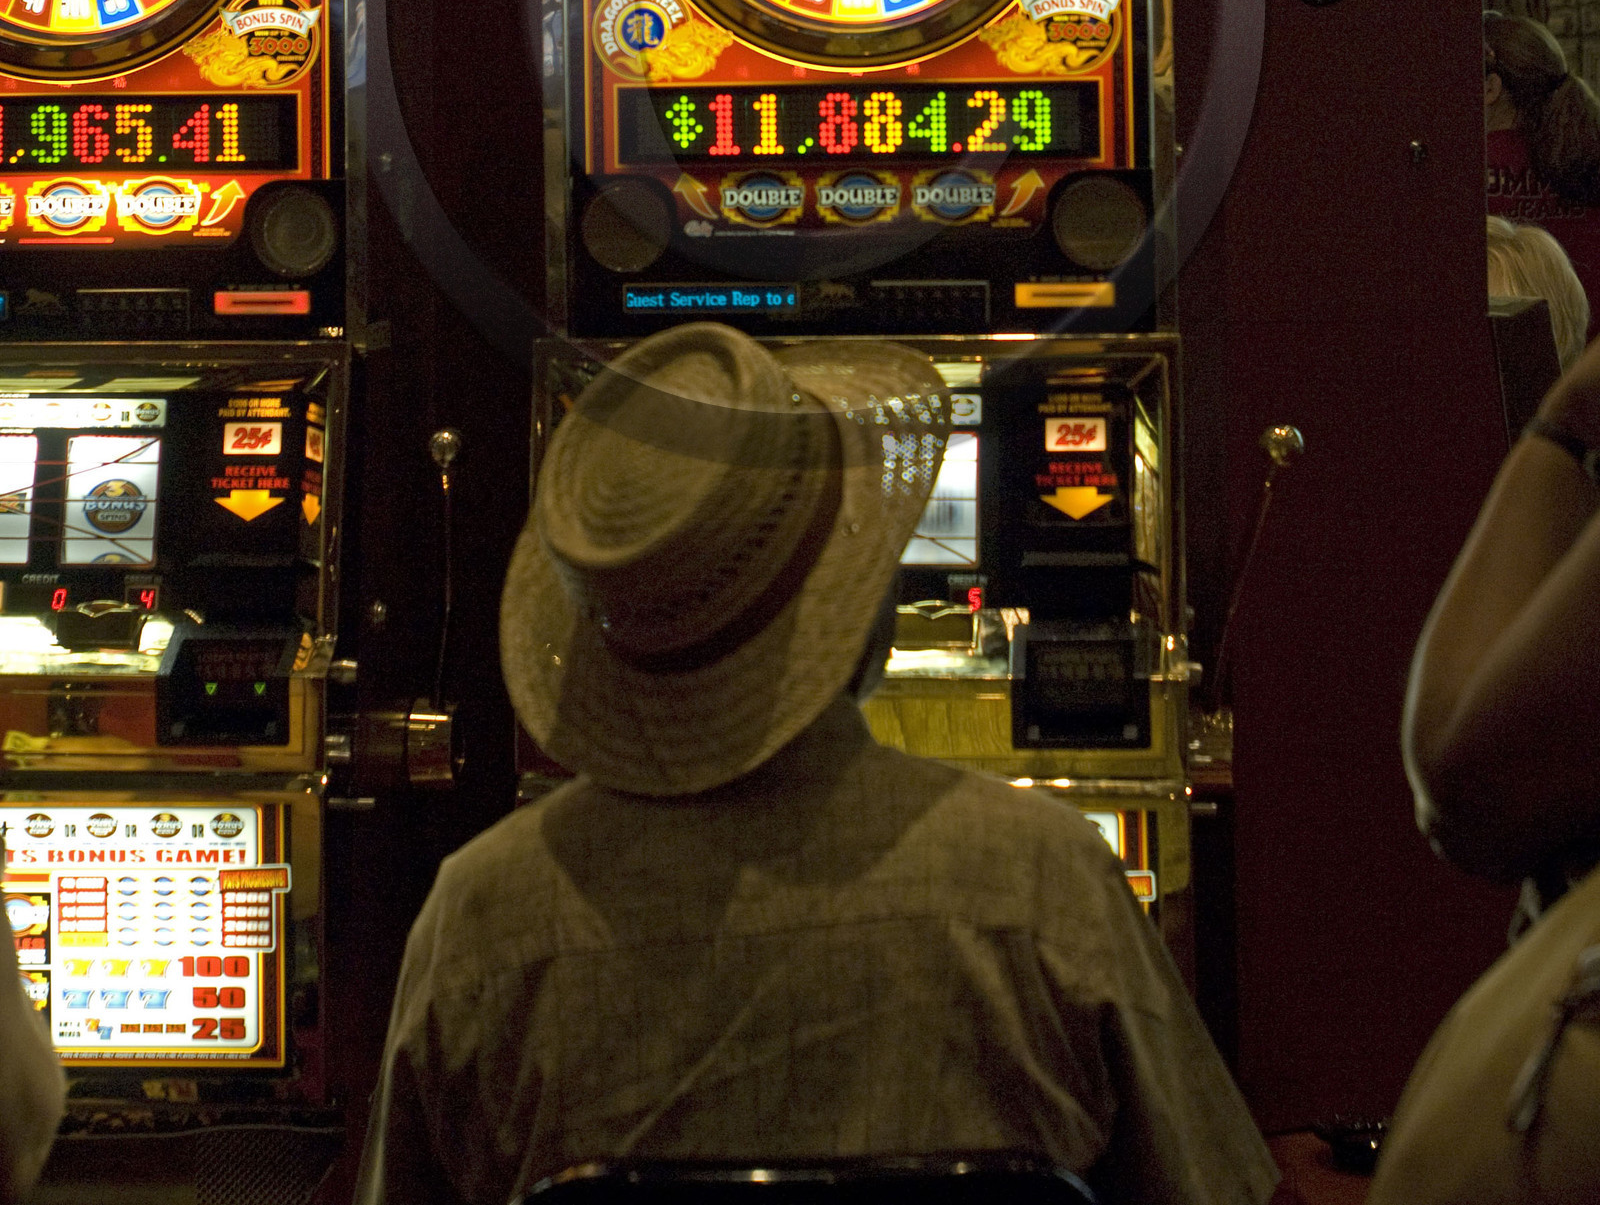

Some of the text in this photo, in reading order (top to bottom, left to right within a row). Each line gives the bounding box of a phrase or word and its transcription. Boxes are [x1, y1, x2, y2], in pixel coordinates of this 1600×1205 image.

[236, 12, 305, 30] BONUS SPIN
[1048, 21, 1112, 42] 3000
[249, 36, 311, 56] 3000
[665, 90, 1052, 156] $11,884.29
[0, 103, 247, 164] ,965.41
[29, 196, 105, 215] DOUBLE
[121, 196, 197, 214] DOUBLE
[724, 187, 801, 208] DOUBLE
[820, 186, 898, 207] DOUBLE
[915, 186, 995, 206] DOUBLE
[670, 292, 727, 307] Service
[732, 291, 760, 307] Rep
[766, 292, 782, 306] to
[231, 426, 273, 450] 25¢
[1055, 423, 1098, 446] 25¢
[225, 465, 277, 477] RECEIVE
[211, 478, 254, 489] TICKET
[257, 478, 290, 489] HERE
[83, 495, 147, 512] BONUS
[99, 513, 128, 522] SPINS
[22, 574, 61, 584] CREDIT
[51, 587, 68, 611] 0
[140, 589, 155, 610] 4
[192, 823, 205, 839] OR
[47, 849, 147, 864] BONUS
[156, 848, 247, 866] GAME!
[178, 955, 250, 978] 100
[192, 986, 246, 1009] 50
[192, 1017, 247, 1040] 25
